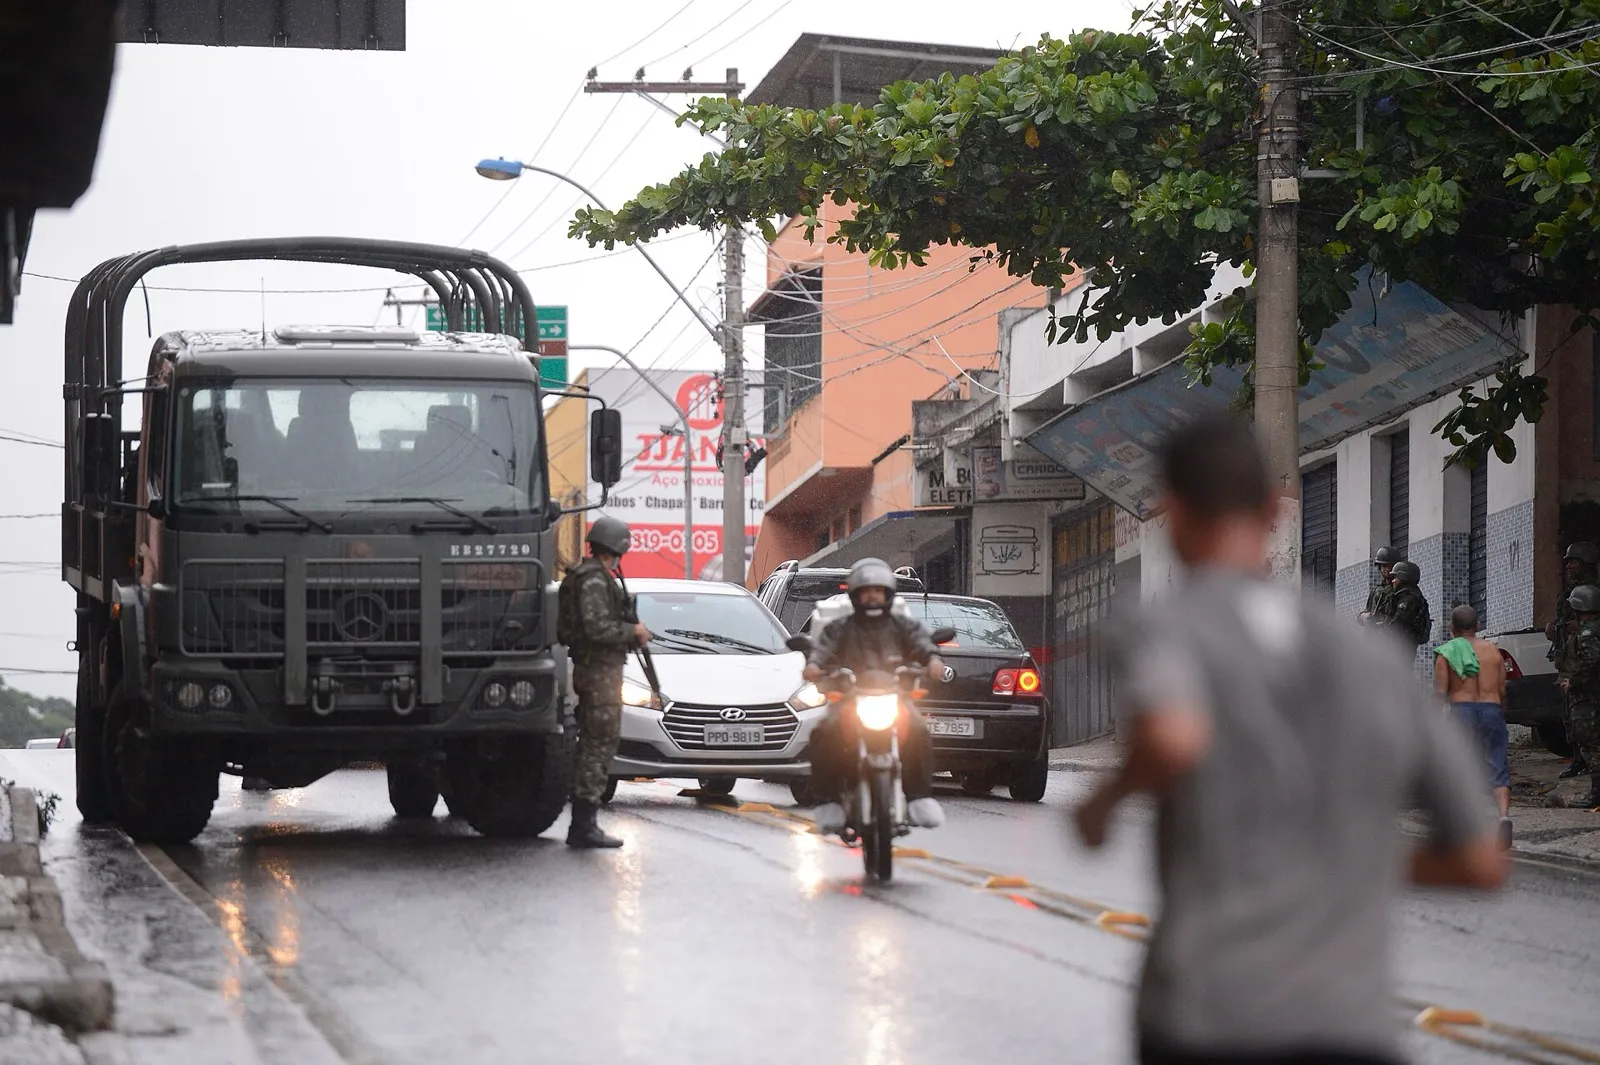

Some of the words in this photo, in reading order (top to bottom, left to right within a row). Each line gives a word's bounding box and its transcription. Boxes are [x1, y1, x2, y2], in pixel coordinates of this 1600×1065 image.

[652, 475, 679, 488] Aço
[602, 496, 636, 507] ubos
[700, 497, 724, 509] Bar
[627, 532, 717, 550] 319-005
[450, 544, 531, 556] EB27720
[926, 722, 971, 734] TE-7857
